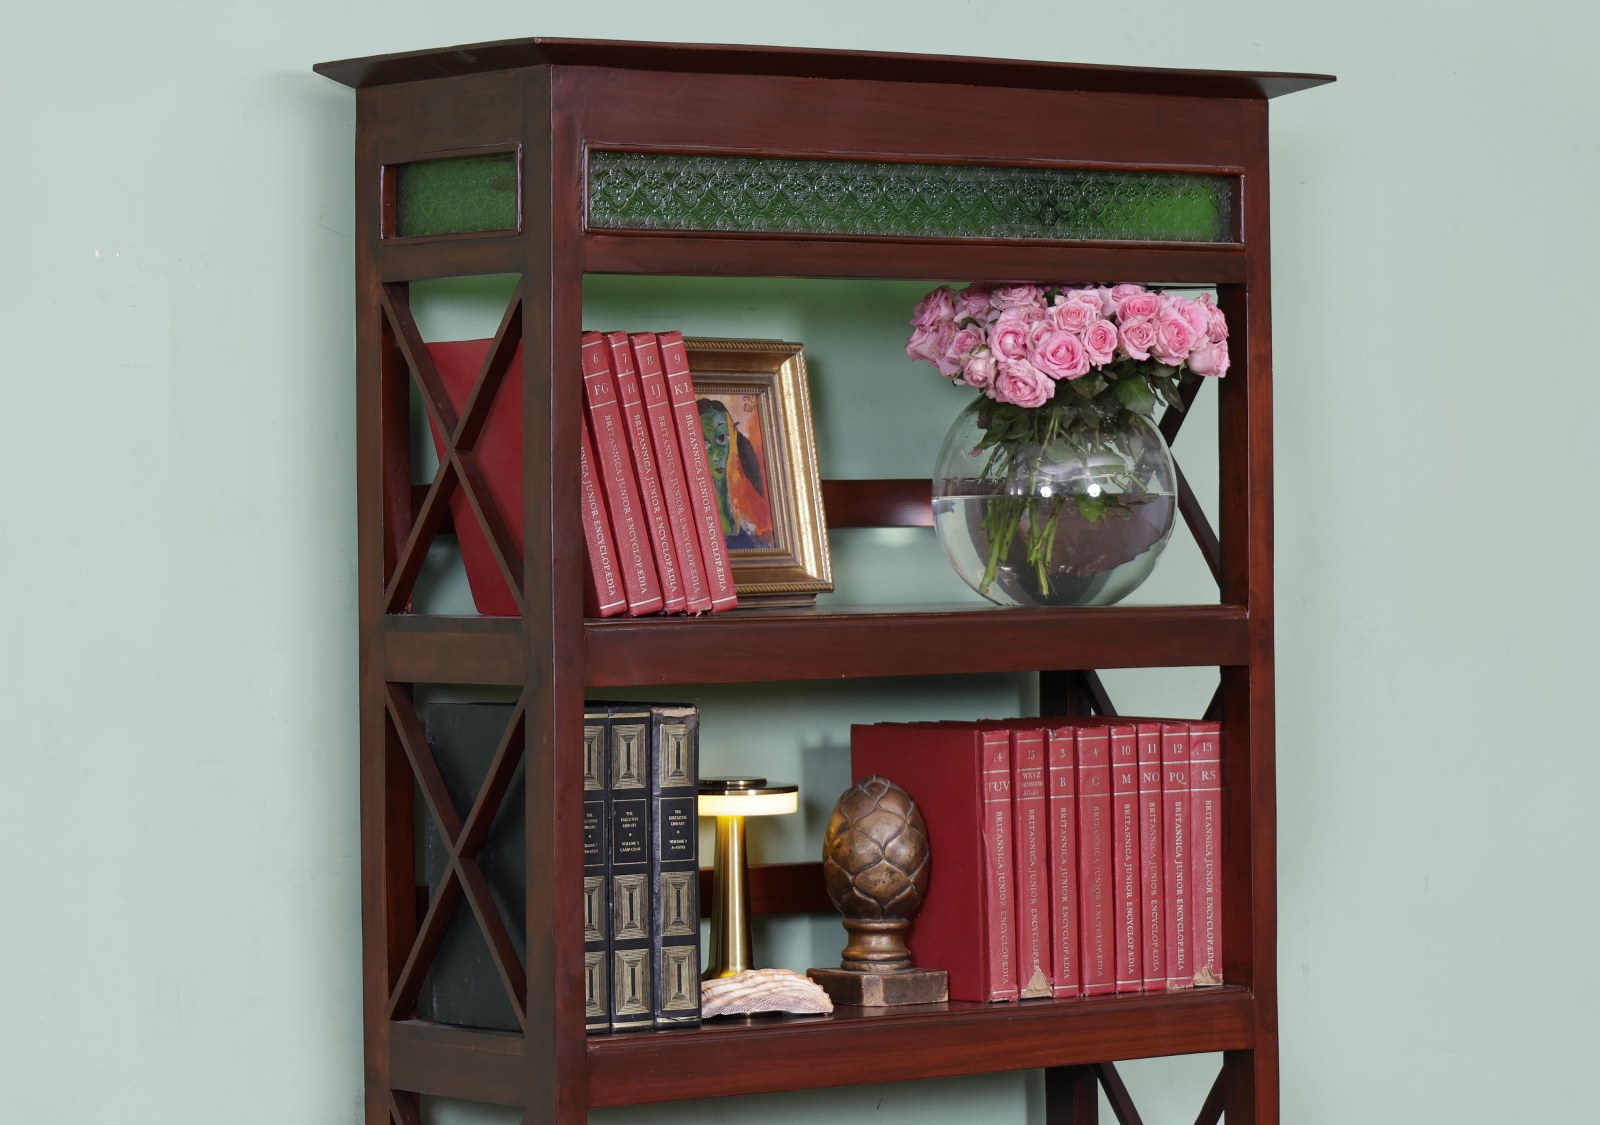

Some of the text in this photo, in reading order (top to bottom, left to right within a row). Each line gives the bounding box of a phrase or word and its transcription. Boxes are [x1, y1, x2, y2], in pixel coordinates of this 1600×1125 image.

[593, 353, 599, 364] 6
[622, 353, 628, 364] 7
[647, 355, 653, 366] 8
[674, 353, 681, 364] 9
[593, 382, 609, 396] FG
[627, 383, 636, 394] H
[650, 383, 661, 398] IJ
[673, 382, 692, 395] KL
[604, 414, 623, 476] BRITANNICA
[615, 475, 631, 514] JUNIOR
[634, 414, 652, 474] BRITANNICA
[645, 475, 661, 513] JUNIOR
[658, 415, 675, 475] BRITANNICA
[668, 476, 684, 514] JUNIOR
[685, 414, 703, 474] BRITANNICA
[695, 475, 711, 513] JUNIOR
[582, 479, 599, 518] JUNIOR
[1060, 748, 1066, 759] 3
[1121, 745, 1131, 756] 10
[1147, 743, 1157, 754] 11
[1172, 743, 1183, 754] 12
[1201, 742, 1212, 752] 13
[1060, 777, 1066, 787] B
[1091, 776, 1100, 786] C
[1122, 774, 1132, 785] M
[1142, 772, 1160, 783] NO
[1169, 771, 1187, 785] PQ
[1201, 770, 1217, 781] RS
[996, 811, 1004, 869] BRITANNICA
[1028, 809, 1036, 866] BRITANNICA
[1123, 862, 1133, 898] JUNIOR
[1148, 860, 1157, 896] JUNIOR
[1174, 858, 1184, 896] JUNIOR
[1205, 857, 1213, 894] JUNIOR
[996, 870, 1007, 906] JUNIOR
[1028, 867, 1037, 905] JUNIOR
[1059, 866, 1069, 901] JUNIOR
[1206, 896, 1214, 968] ENCYCLOPÆDI
